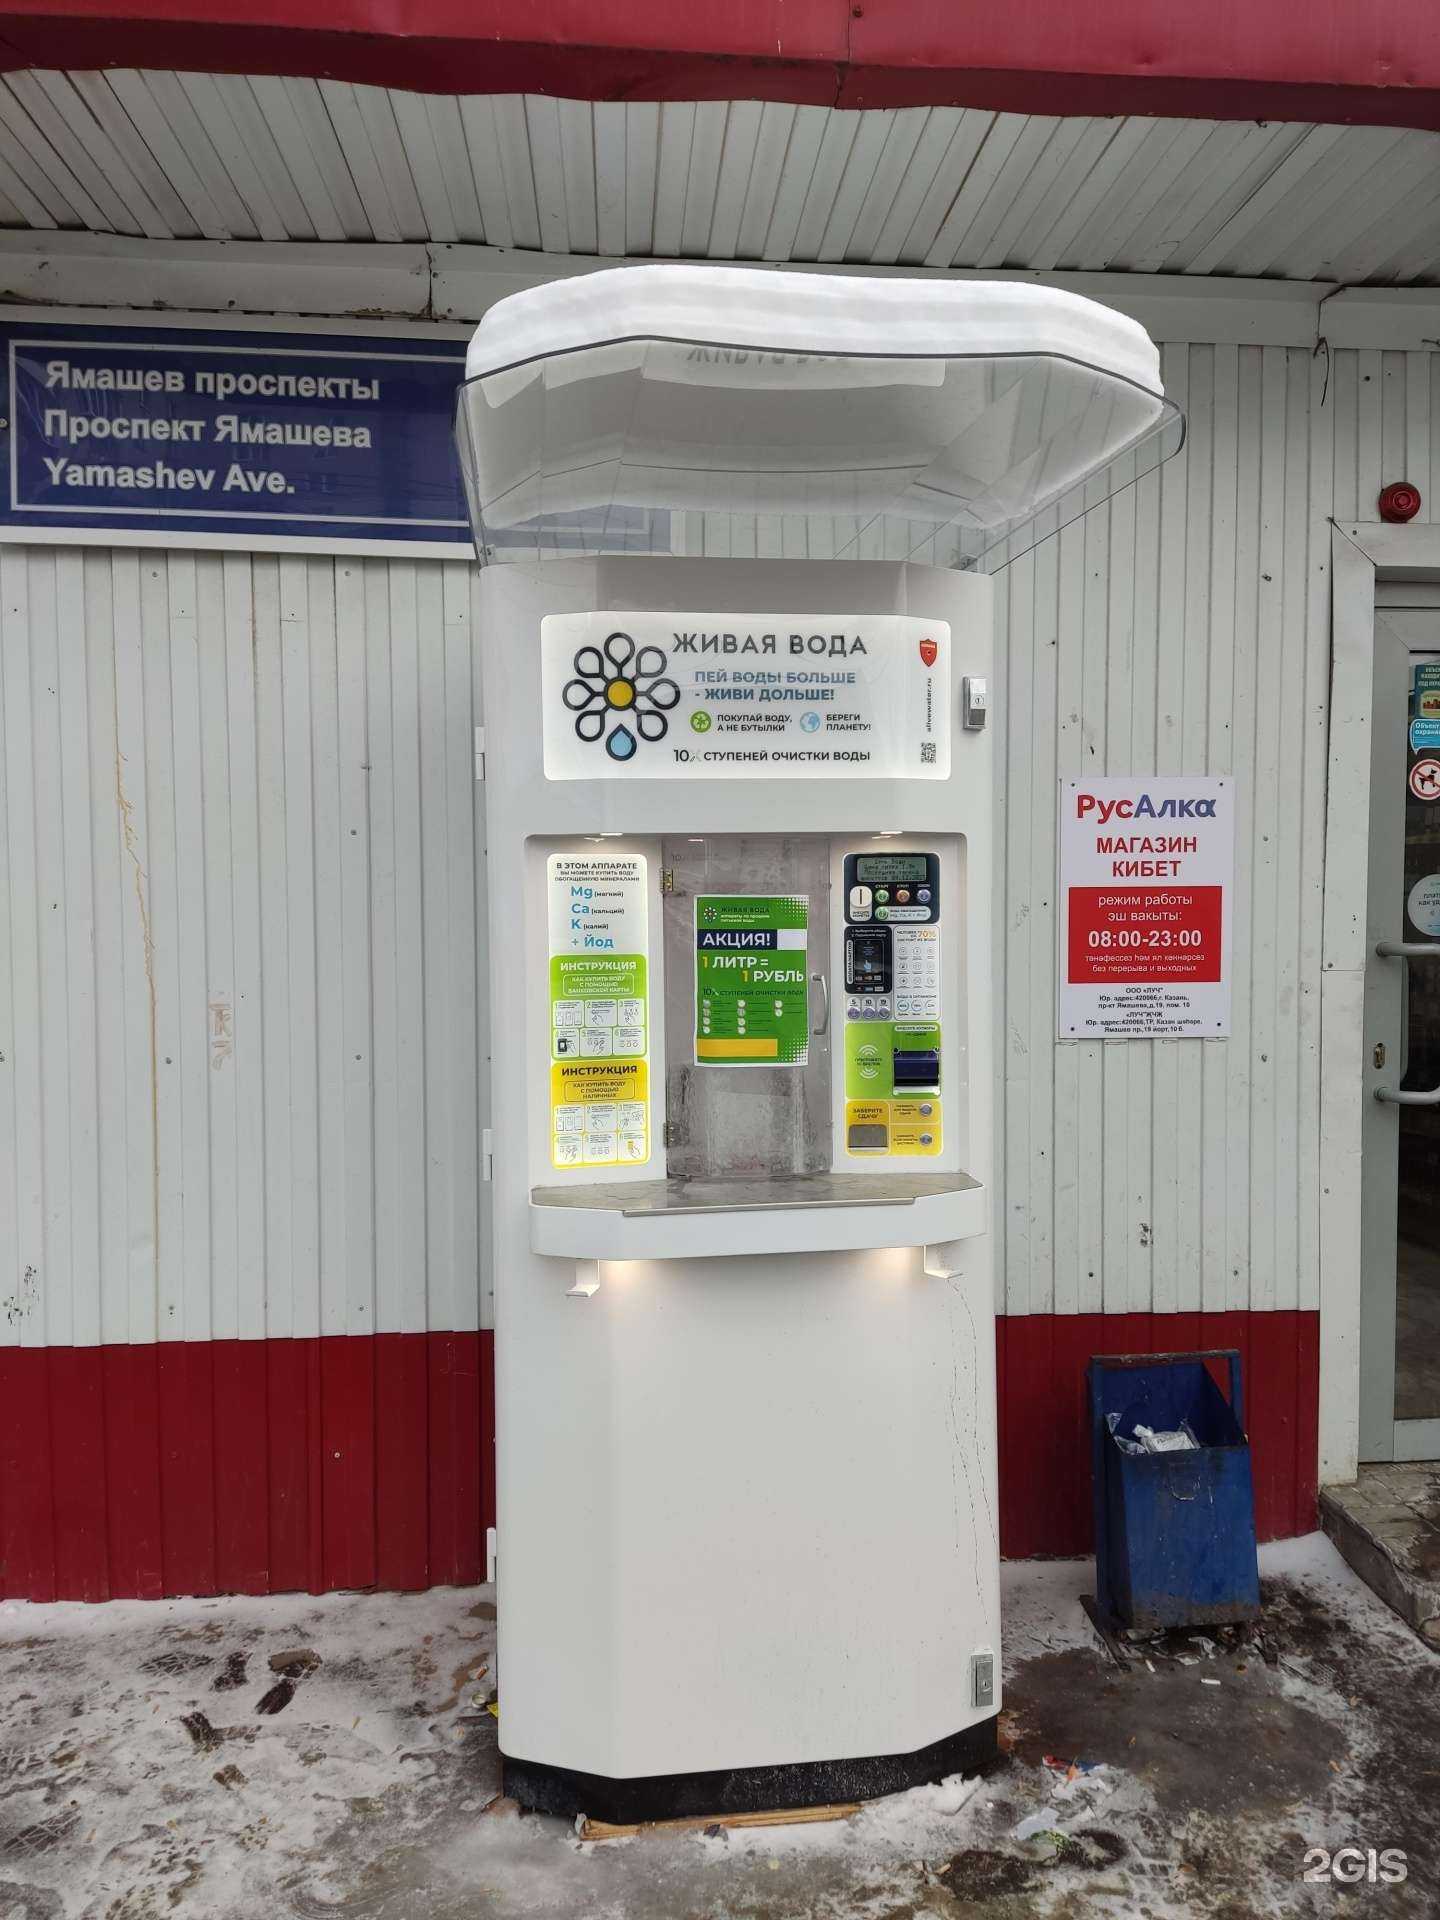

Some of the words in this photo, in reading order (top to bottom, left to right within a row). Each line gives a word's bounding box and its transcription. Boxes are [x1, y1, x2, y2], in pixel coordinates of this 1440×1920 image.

[45, 360, 184, 393] Ямашев
[196, 370, 380, 400] проспекты
[44, 409, 204, 444] Проспект
[213, 415, 372, 448] Ямашева
[43, 457, 216, 492] Yamashev
[222, 464, 296, 494] Ave.
[673, 633, 776, 654] ЖИВАЯ
[789, 635, 867, 657] ВОДА
[694, 669, 727, 683] ПЕЙ
[733, 671, 781, 684] ВОДЫ
[786, 672, 856, 684] БОЛЬШЕ
[704, 688, 754, 700] ЖИВИ
[759, 689, 835, 702] ДОЛЬШЕ!
[717, 713, 763, 722] ПОКУПАЙ
[765, 714, 793, 723] ВОДУ,
[741, 724, 785, 732] БУТЫЛКИ
[826, 723, 871, 731] ПЛАНЕТУ!
[704, 749, 768, 761] СТУПЕНЕЙ
[772, 751, 830, 761] ОЧИСТКИ
[833, 751, 870, 762] ВОДЫ
[1077, 794, 1216, 824] РусАлка
[1096, 837, 1197, 853] МАГАЗИН
[1112, 861, 1181, 877] КИБЕТ
[571, 886, 593, 899] Mg
[1098, 896, 1140, 908] режим
[1145, 894, 1192, 907] работы
[571, 904, 590, 913] Ca
[1108, 912, 1126, 921] эш
[1131, 911, 1182, 921] вакыты:
[584, 934, 614, 948] Йод
[703, 933, 771, 948] АКЦИЯ!
[1088, 930, 1202, 947] 08:00-23:00
[560, 961, 636, 971] ИНСТРУКЦИЯ
[702, 956, 708, 968] 1
[712, 956, 757, 968] ЛИТР
[742, 970, 748, 982] 1
[753, 970, 804, 982] РУБЛЬ
[562, 1066, 637, 1075] ИНСТРУКЦИЯ
